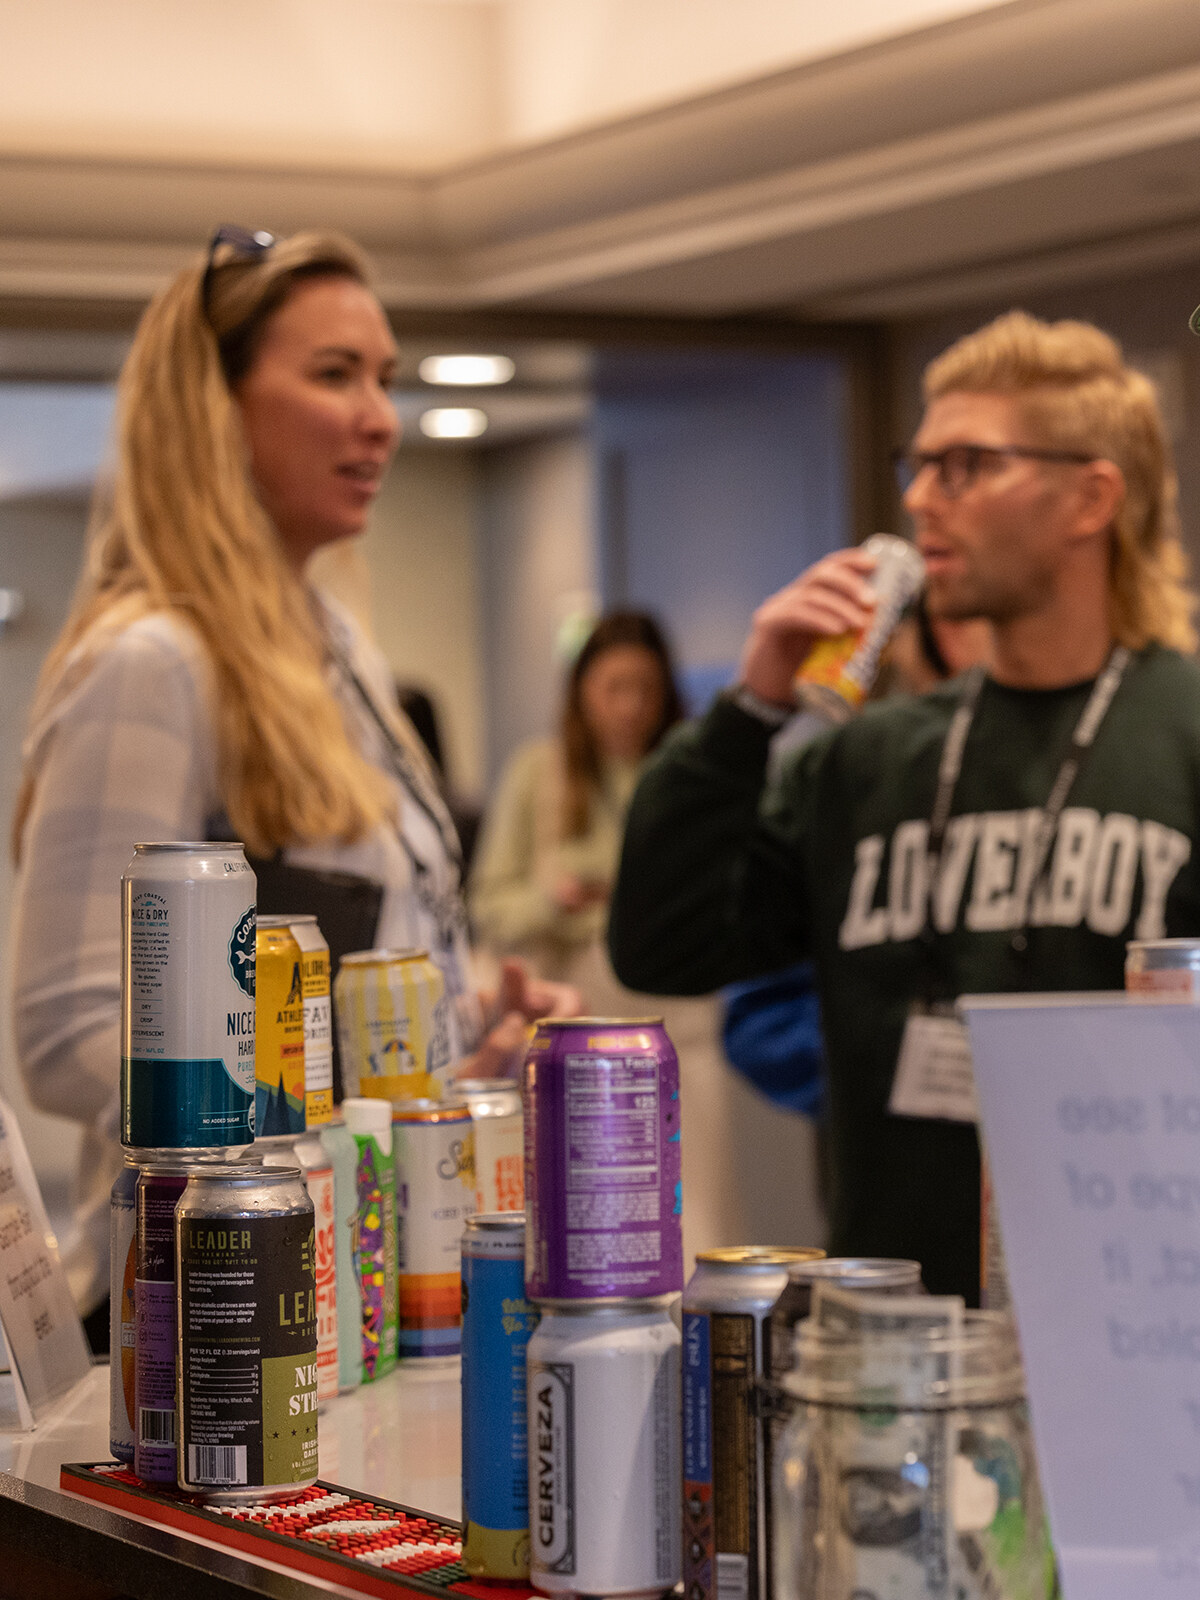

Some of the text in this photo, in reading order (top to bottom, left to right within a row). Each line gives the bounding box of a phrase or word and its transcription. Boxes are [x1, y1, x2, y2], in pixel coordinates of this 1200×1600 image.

[838, 806, 1193, 952] LOVERBOY
[152, 909, 169, 920] DRY
[226, 1011, 251, 1036] NICE
[189, 1230, 251, 1250] LEADER
[537, 1385, 554, 1548] CERVEZA
